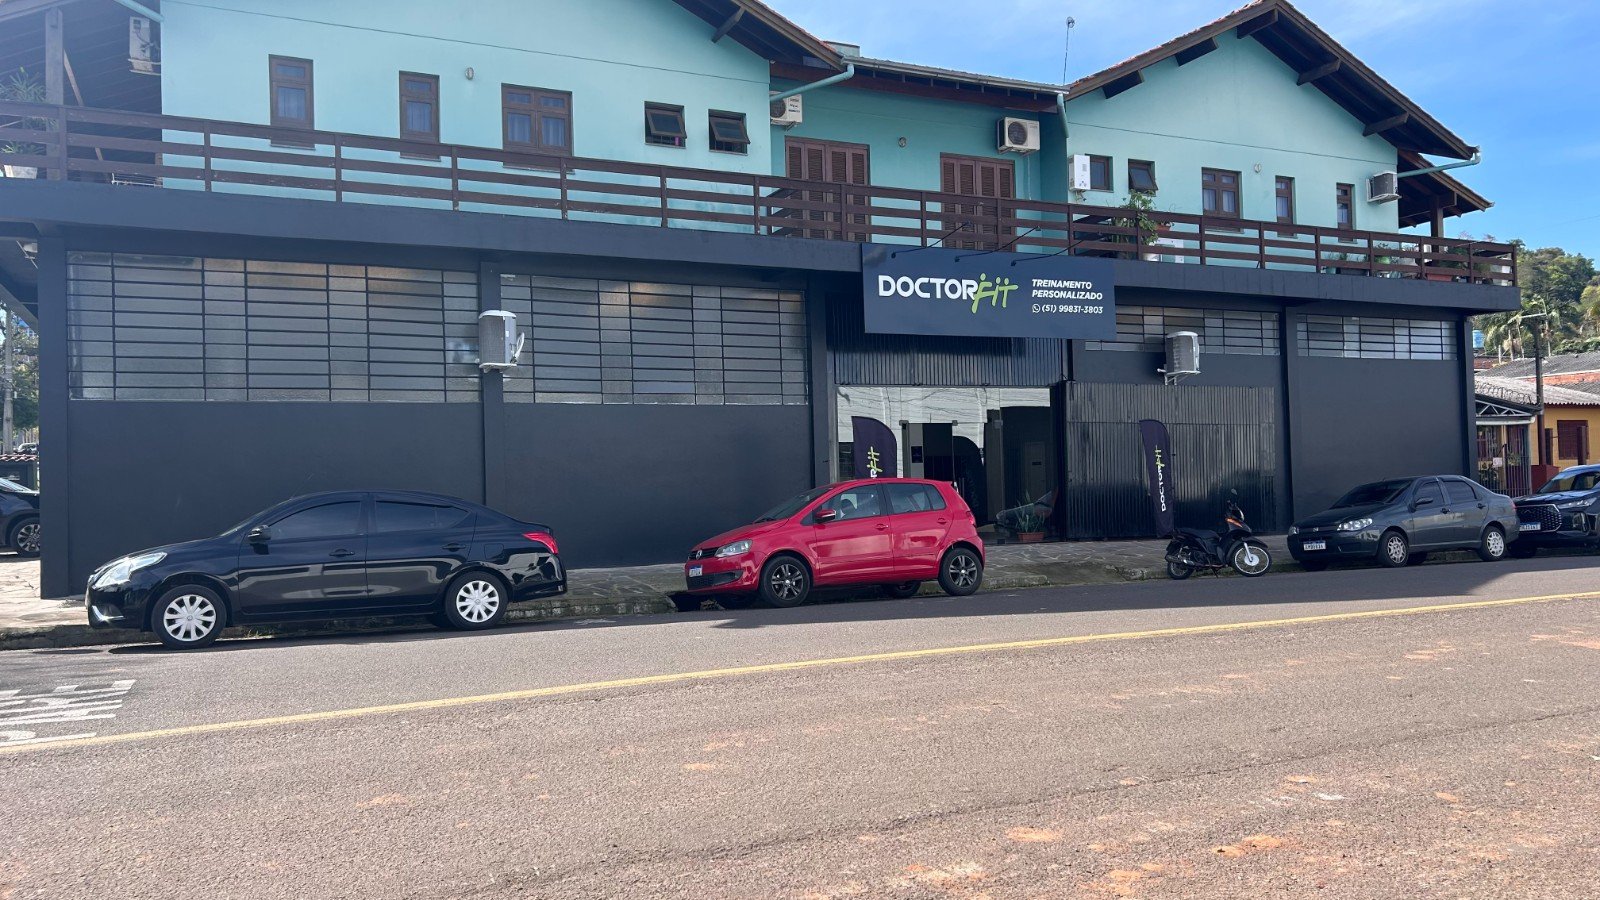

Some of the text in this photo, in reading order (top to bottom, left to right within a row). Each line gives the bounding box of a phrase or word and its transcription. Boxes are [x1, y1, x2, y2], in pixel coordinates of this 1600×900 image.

[1032, 279, 1092, 289] TREINAMENTO
[1032, 290, 1103, 300] PERSONALIZADO
[1042, 304, 1103, 314] (51) 99831-3803
